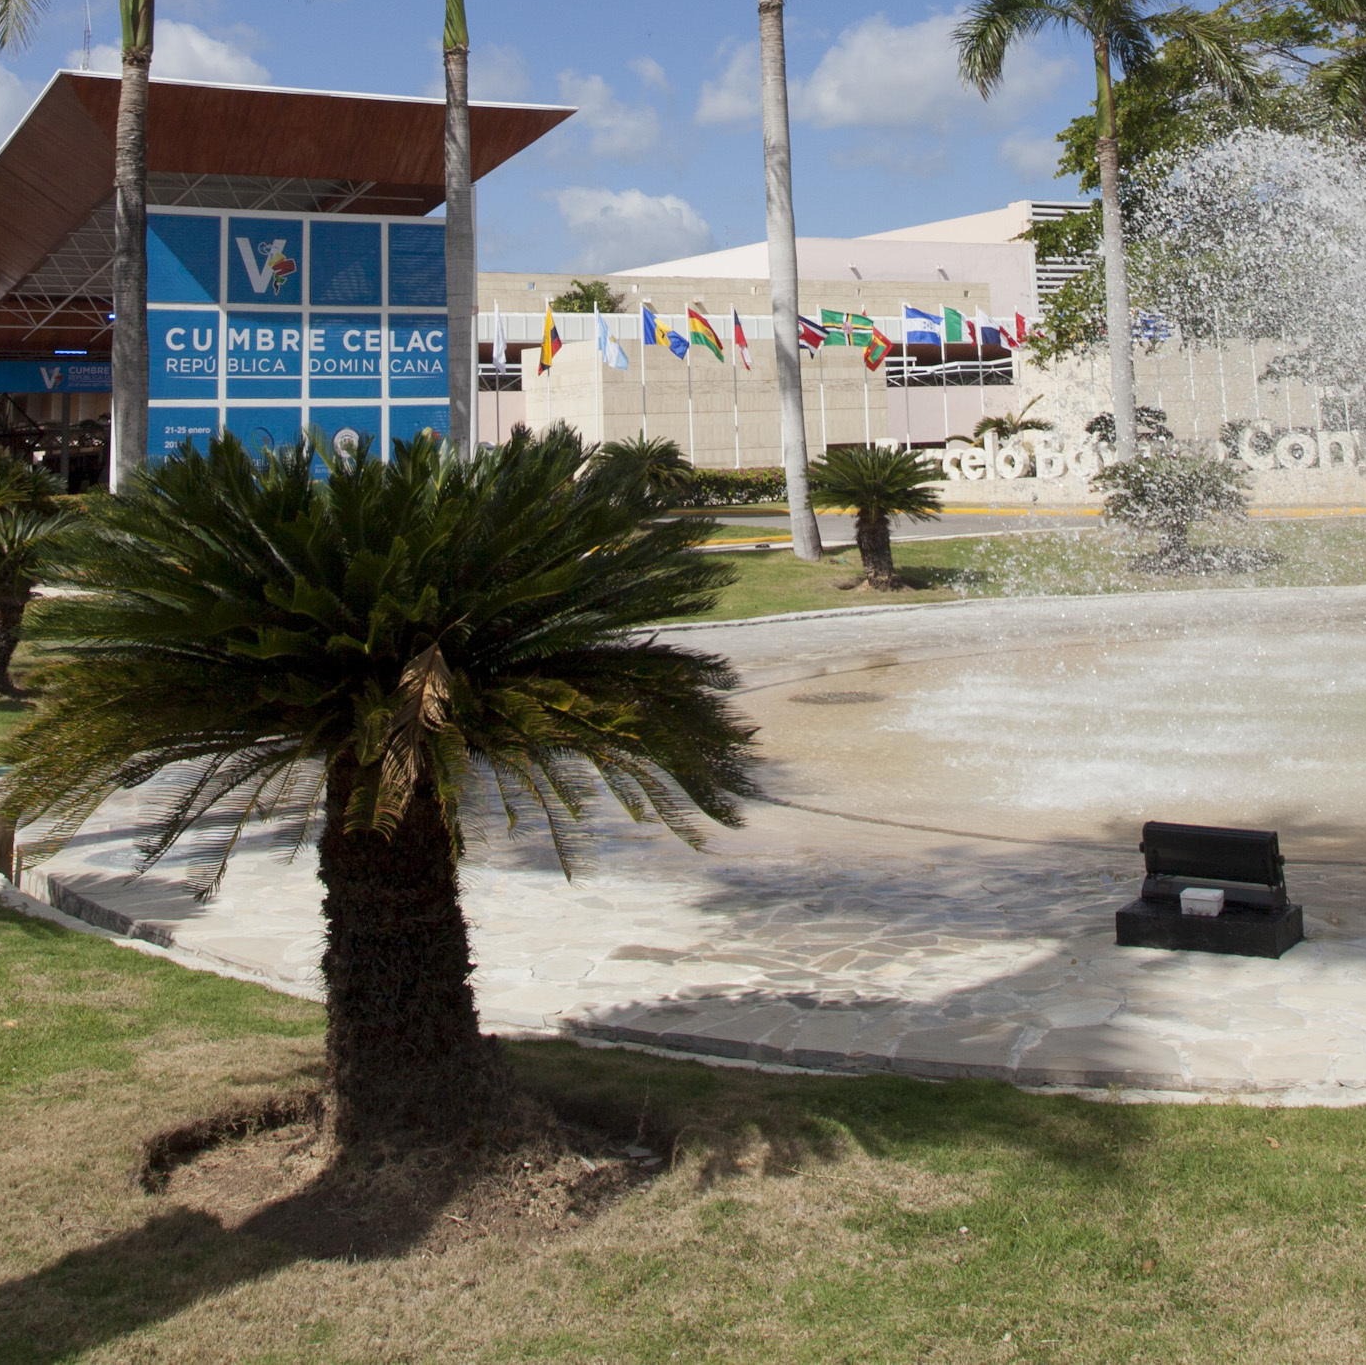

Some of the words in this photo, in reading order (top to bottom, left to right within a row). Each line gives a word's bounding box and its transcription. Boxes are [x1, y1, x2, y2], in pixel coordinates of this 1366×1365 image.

[165, 327, 326, 352] CUMBRE
[342, 329, 444, 353] CELAC
[68, 366, 110, 375] CUMBRE
[166, 355, 286, 373] REPÚBLICA
[310, 358, 444, 373] DOMINICANA
[164, 426, 187, 434] 21-25
